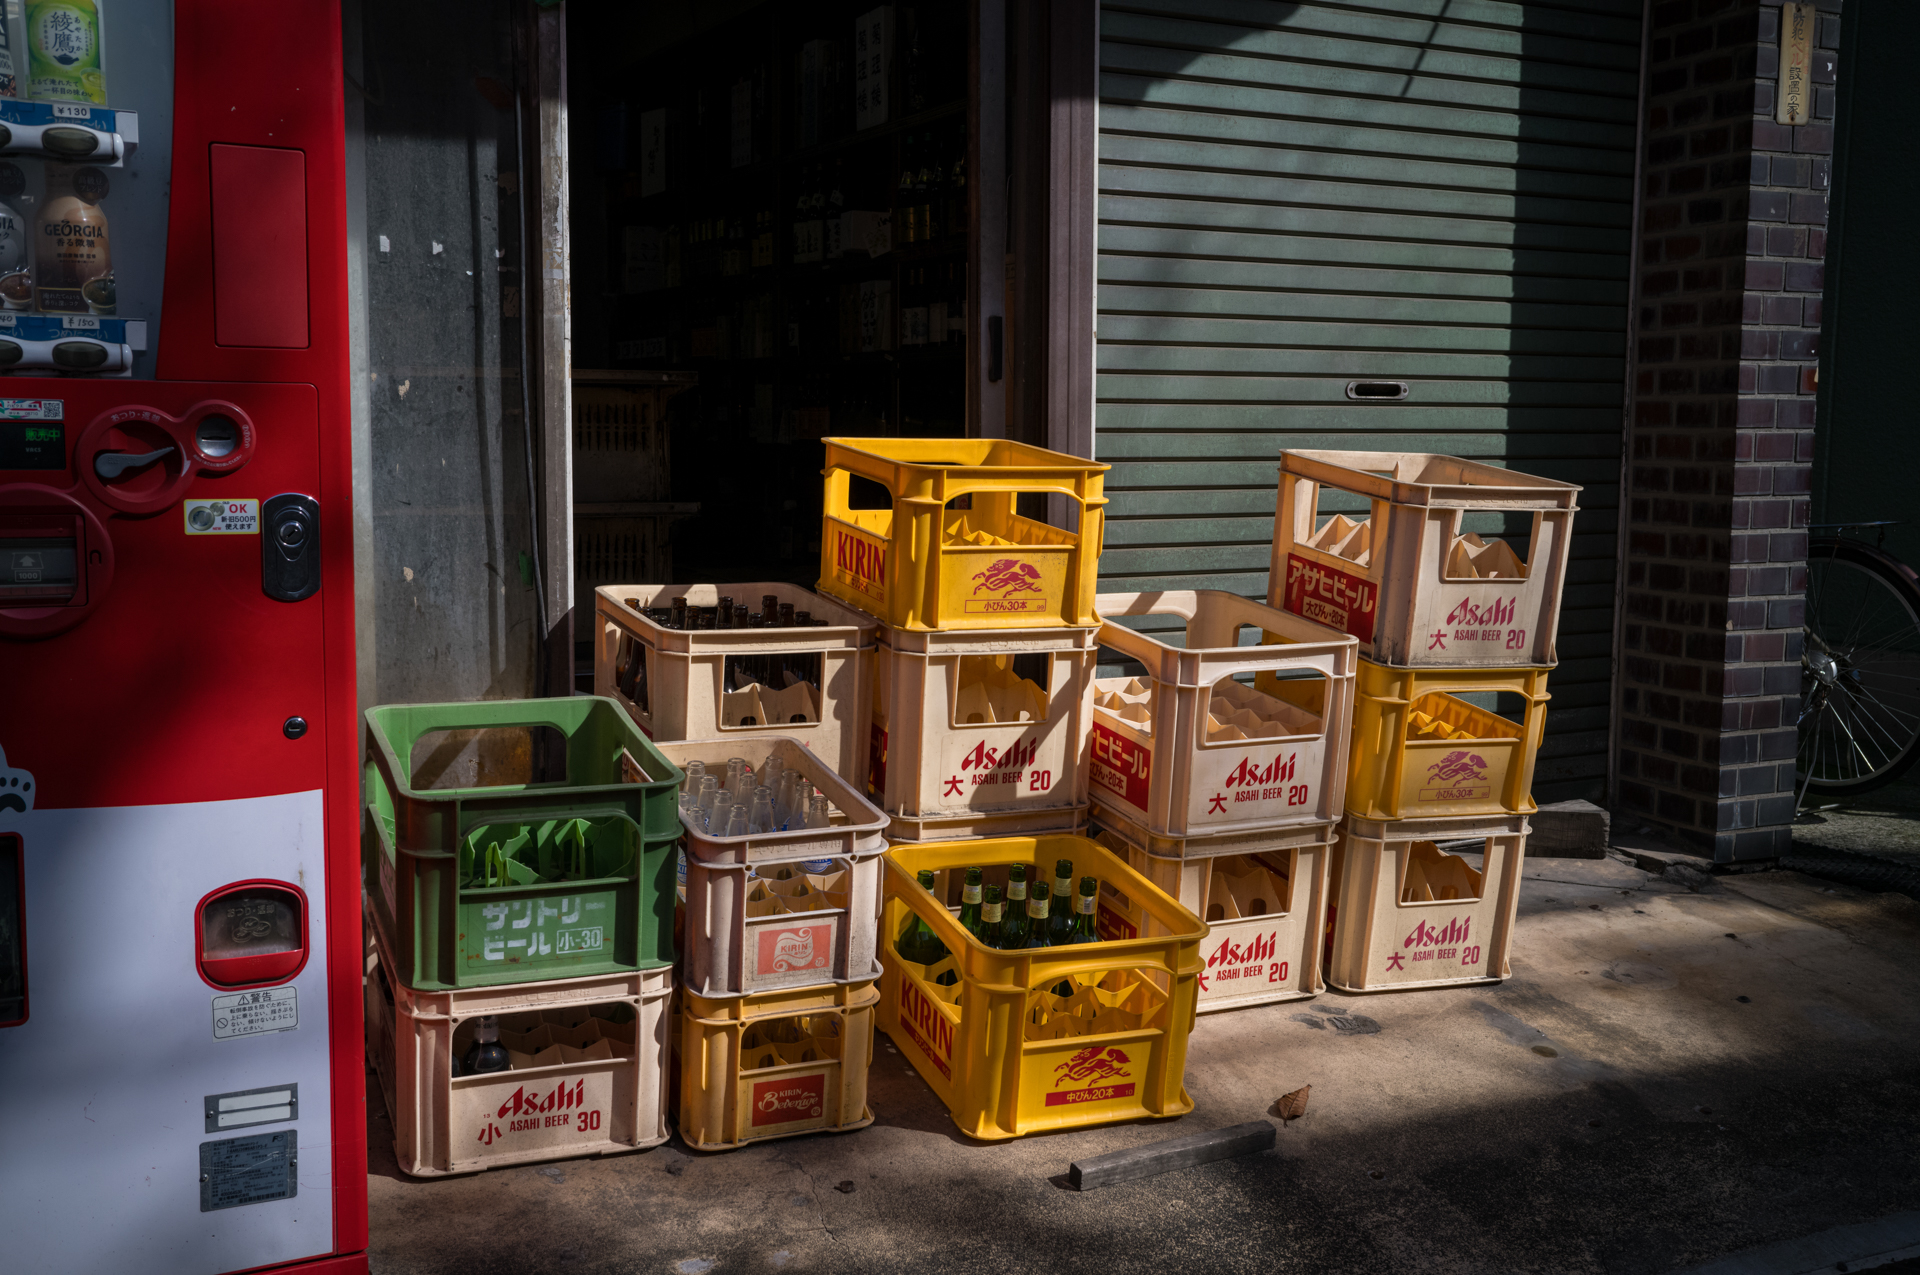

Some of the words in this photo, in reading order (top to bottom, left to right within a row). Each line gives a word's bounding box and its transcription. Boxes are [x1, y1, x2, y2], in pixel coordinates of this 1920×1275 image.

[50, 11, 75, 53] 綾鷹
[74, 16, 83, 51] あやたか
[57, 106, 88, 117] ¥130
[44, 219, 104, 239] GEORGIA
[56, 238, 96, 248] 香る微糖
[229, 503, 248, 514] OK
[225, 523, 253, 531] 使えます
[837, 530, 886, 587] KIRIN
[18, 572, 38, 580] 1000
[1289, 558, 1374, 613] アサヒビール
[983, 601, 1028, 611] 小びん30本
[1446, 596, 1517, 626] Asahi
[1428, 628, 1448, 650] 大
[1453, 629, 1479, 641] ASAHI
[1481, 629, 1502, 641] BEER
[1505, 628, 1526, 650] 20
[961, 736, 1037, 771] Asahi
[1093, 728, 1148, 780] ヒビール
[943, 775, 964, 798] 大
[971, 773, 998, 786] ASAHI
[1002, 771, 1023, 784] BEER
[1029, 769, 1051, 791] 20
[1225, 752, 1297, 789] Asahi
[1207, 792, 1228, 815] 大
[1234, 789, 1260, 803] ASAHI
[1262, 787, 1283, 800] BEER
[1288, 784, 1308, 806] 20
[1435, 789, 1474, 799] 小びん30本
[482, 897, 606, 931] サントリー
[483, 931, 552, 961] ビール
[1404, 915, 1471, 949] Asahi
[780, 943, 809, 953] KIRIN
[1207, 931, 1277, 968] Asahi
[1385, 951, 1406, 972] 大
[1412, 949, 1435, 962] ASAHI
[1437, 948, 1457, 960] BEER
[1461, 945, 1481, 966] 20
[1216, 967, 1241, 981] ASAHI
[1243, 965, 1263, 978] BEER
[1268, 961, 1289, 983] 20
[250, 991, 272, 1004] 警告
[901, 974, 953, 1062] KIRIN
[497, 1077, 584, 1119] Asahi
[758, 1091, 819, 1112] Beverage
[779, 1088, 802, 1098] KIRIN
[1066, 1087, 1114, 1102] 中びん20本
[477, 1122, 503, 1146] 小
[509, 1117, 540, 1133] ASAHI
[544, 1113, 569, 1128] BEER
[577, 1109, 601, 1132] 30
